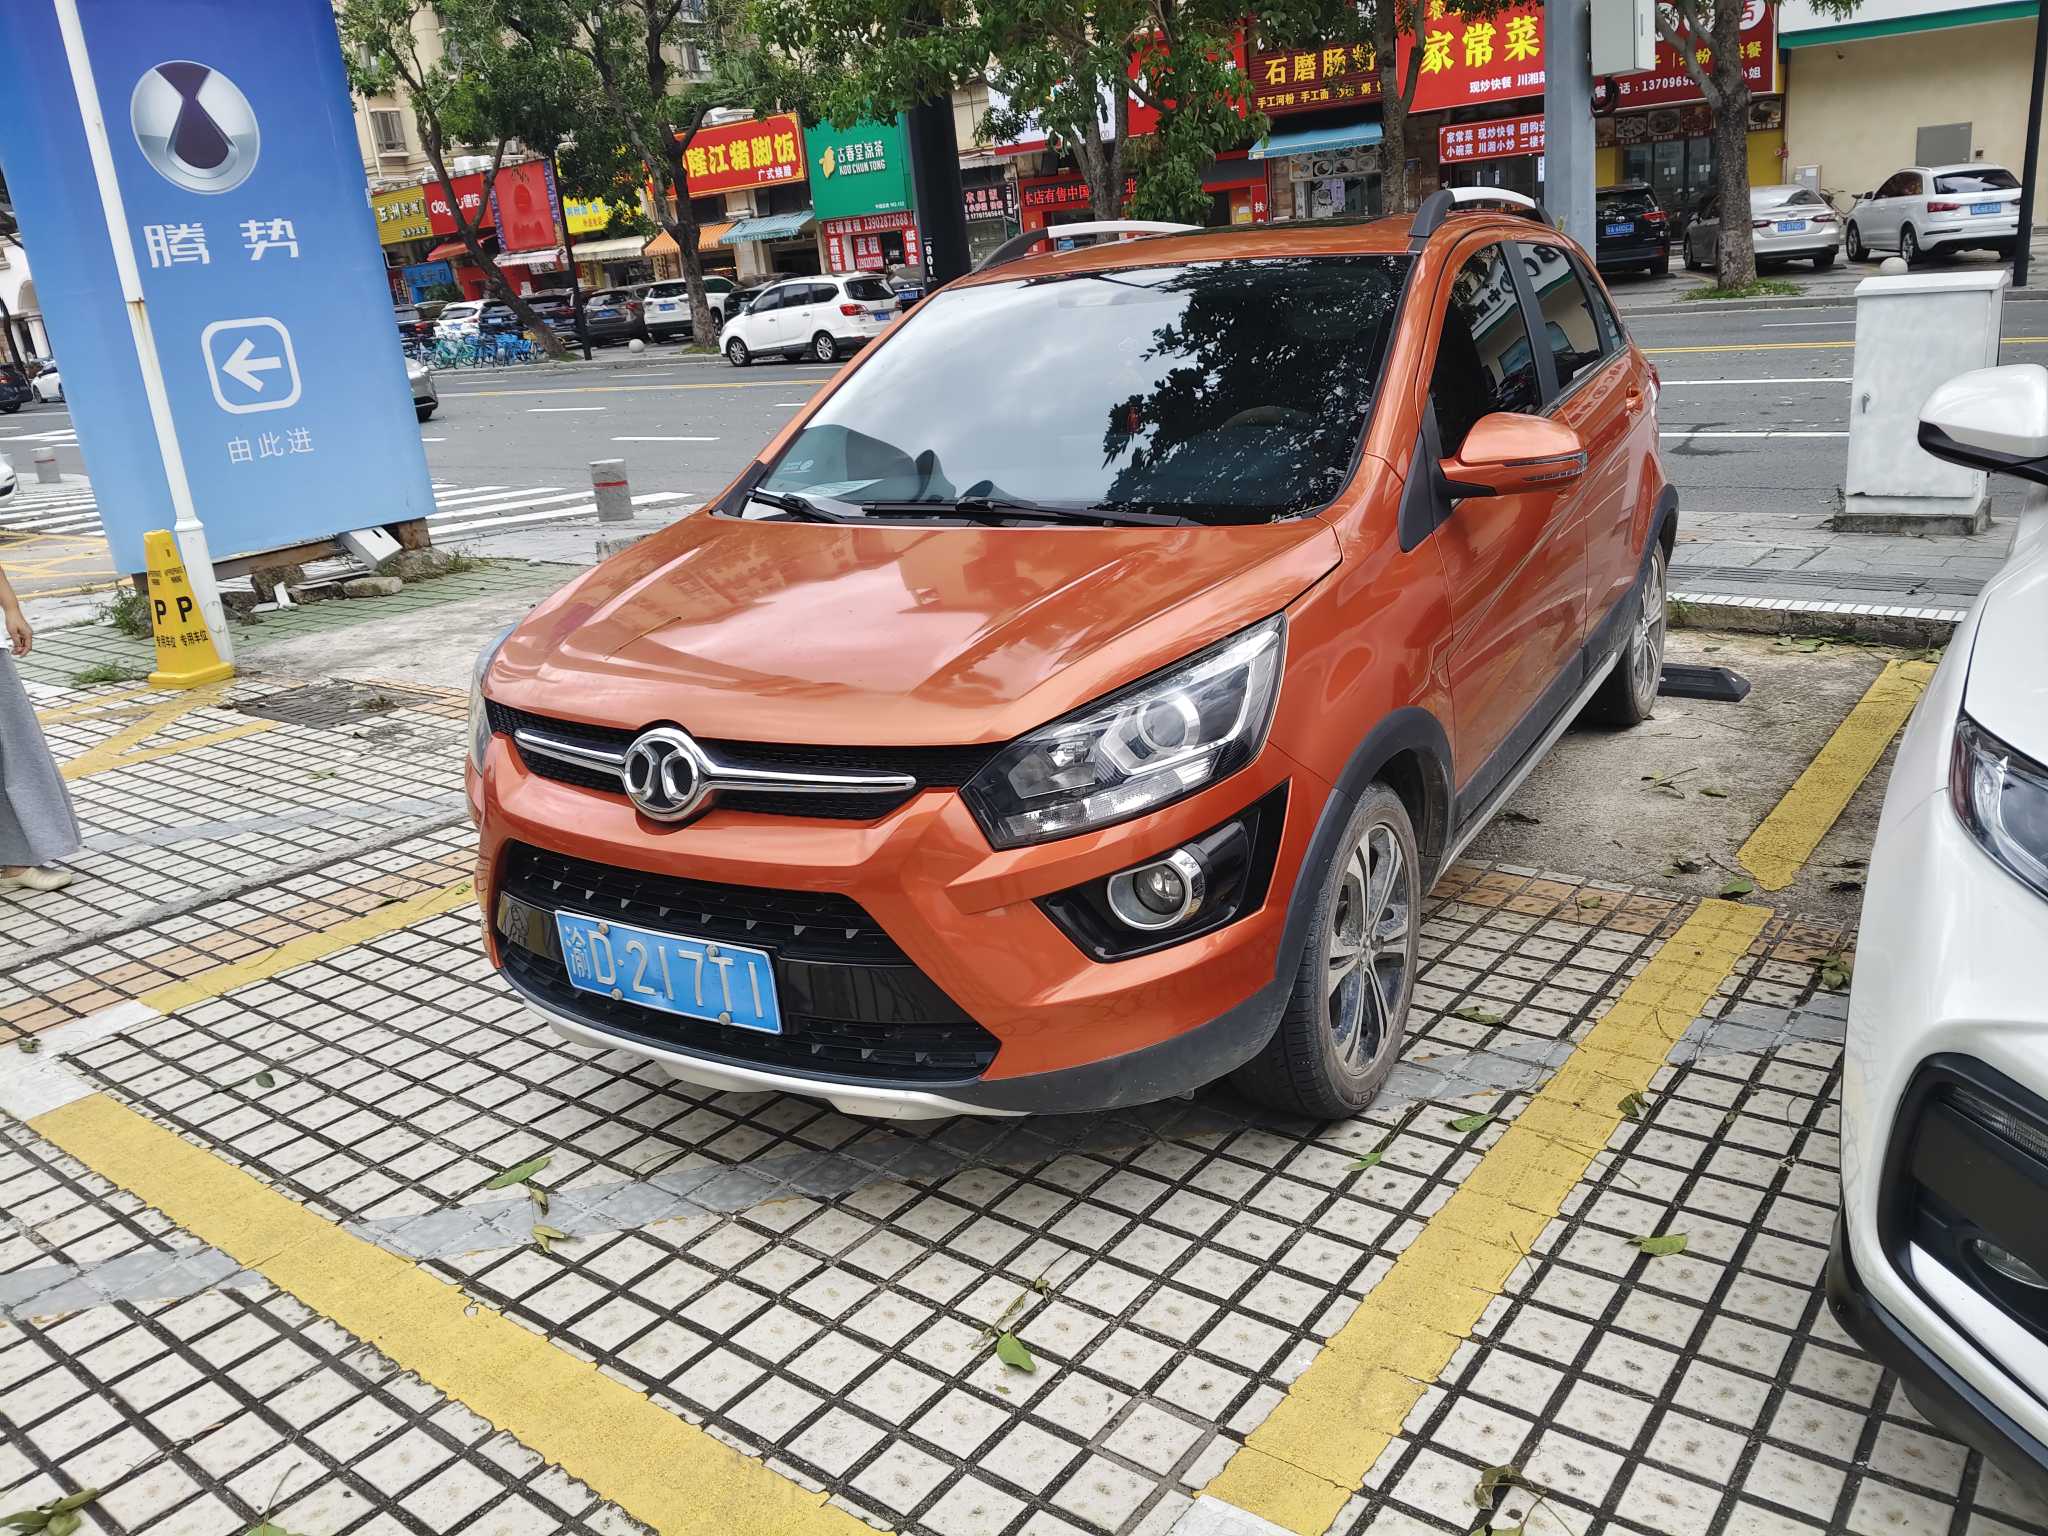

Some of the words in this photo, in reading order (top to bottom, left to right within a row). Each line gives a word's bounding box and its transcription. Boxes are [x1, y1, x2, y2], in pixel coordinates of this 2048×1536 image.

[1420, 15, 1540, 75] 家常菜
[1469, 76, 1512, 94] 现炒快餐
[1257, 93, 1295, 109] 手工河粉
[1301, 88, 1329, 103] 手工面
[1446, 129, 1473, 144] 家常菜
[1478, 124, 1515, 140] 现炒快餐
[686, 132, 797, 178] 隆江猪脚饭
[838, 140, 884, 163] 古春堂凉茶
[1446, 143, 1473, 158] 小碗菜
[143, 217, 300, 268] 腾势
[227, 428, 315, 465] 由此进
[154, 599, 167, 625] P
[176, 596, 193, 623] P
